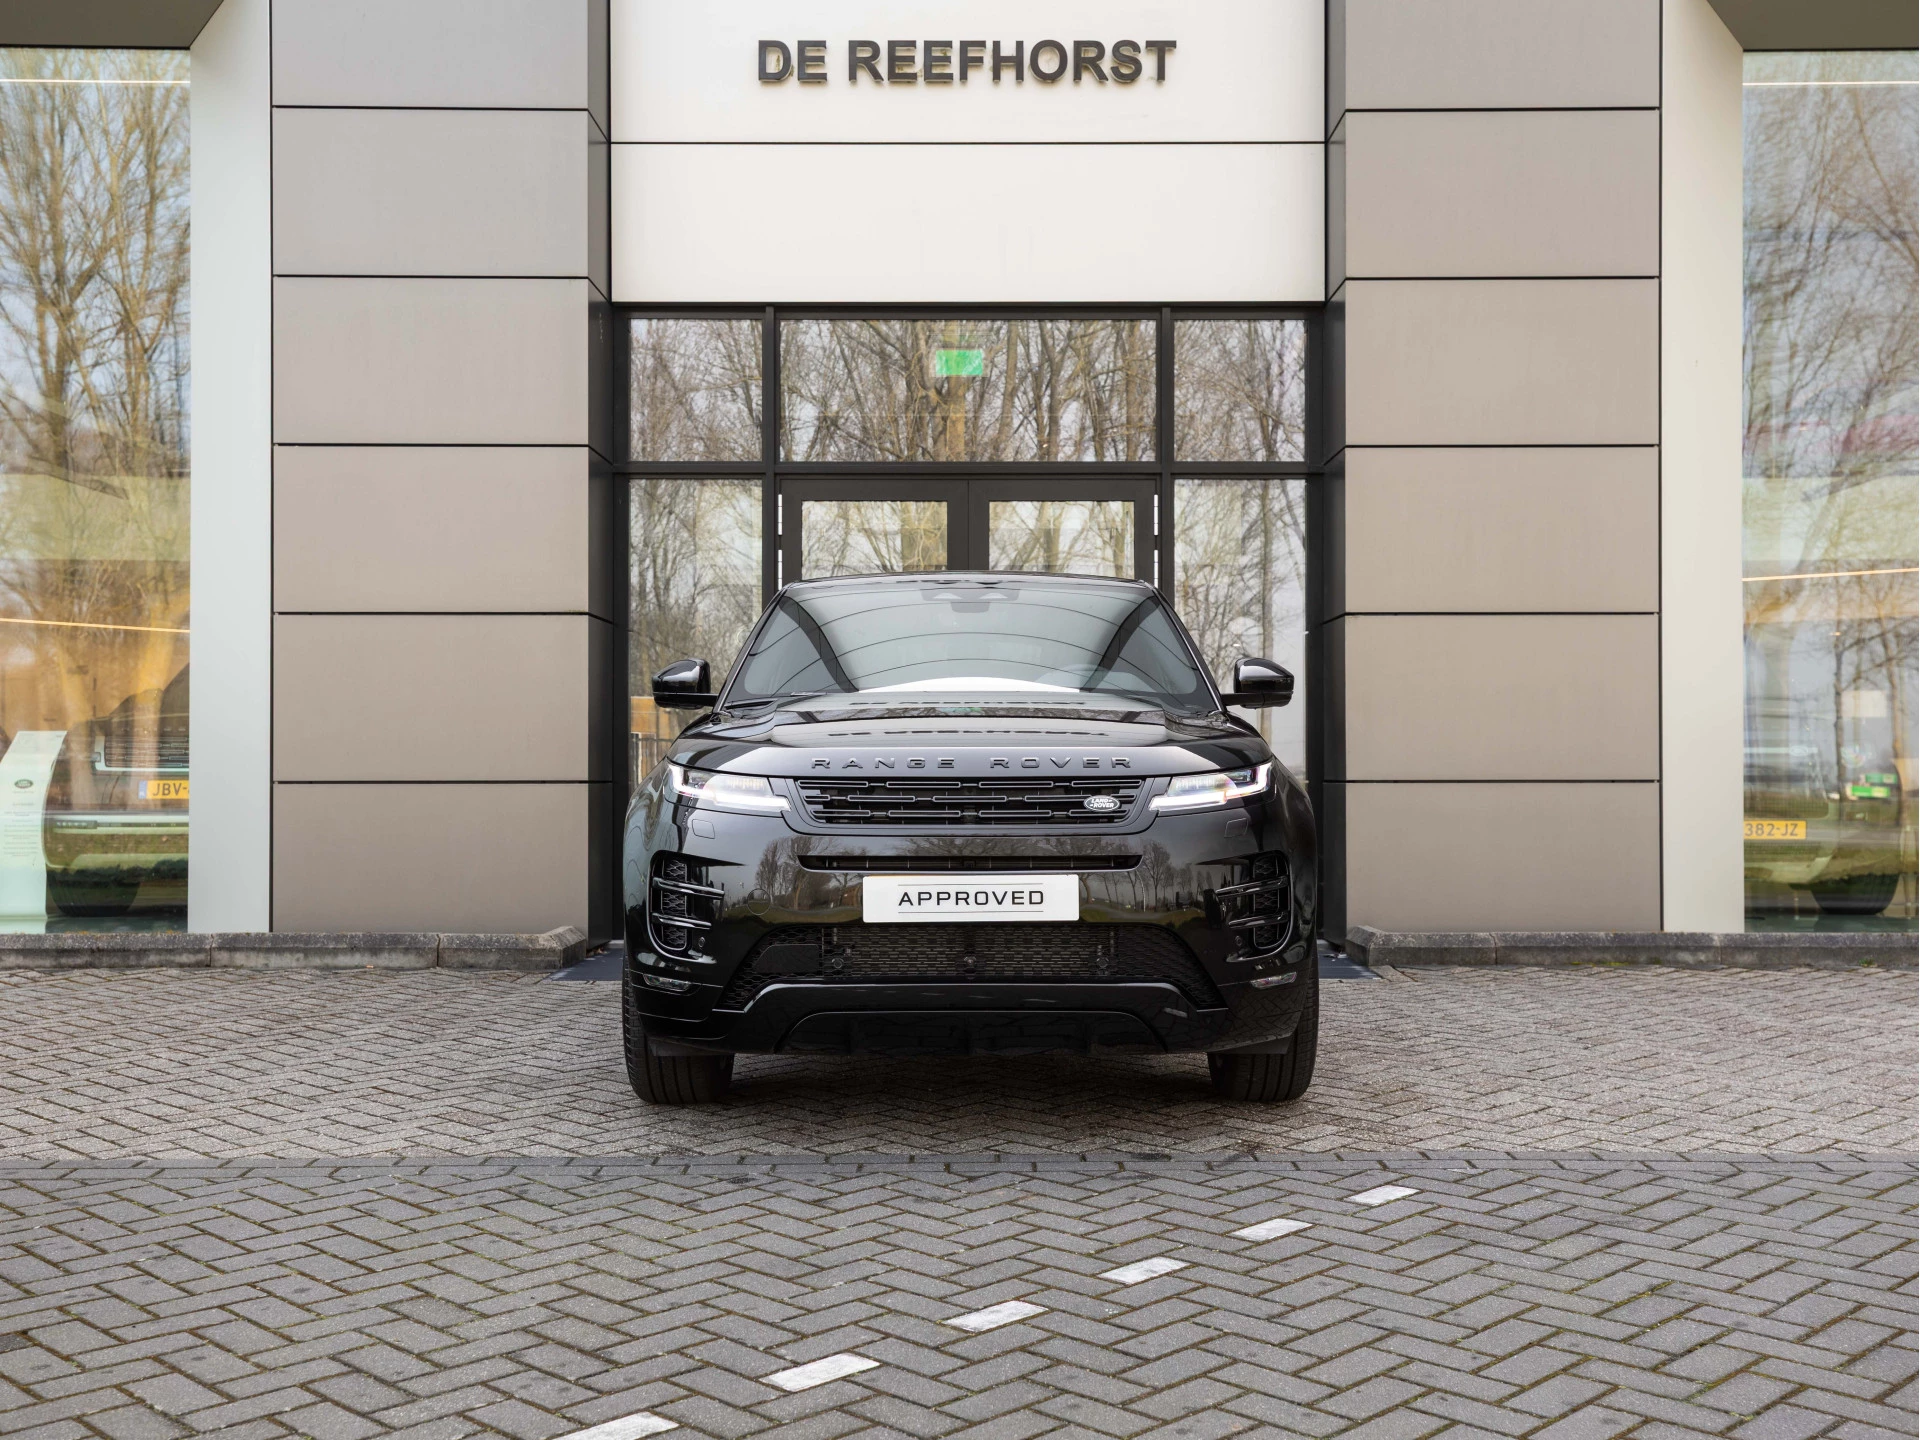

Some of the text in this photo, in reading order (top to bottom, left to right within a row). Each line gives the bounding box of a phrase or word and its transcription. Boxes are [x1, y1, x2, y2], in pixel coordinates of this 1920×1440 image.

[758, 40, 1178, 83] DE REEFHORST
[810, 757, 1132, 769] RANGE ROVER
[152, 782, 189, 796] JBV-
[1744, 823, 1799, 837] 382-JZ
[898, 890, 1044, 906] APPROVED
